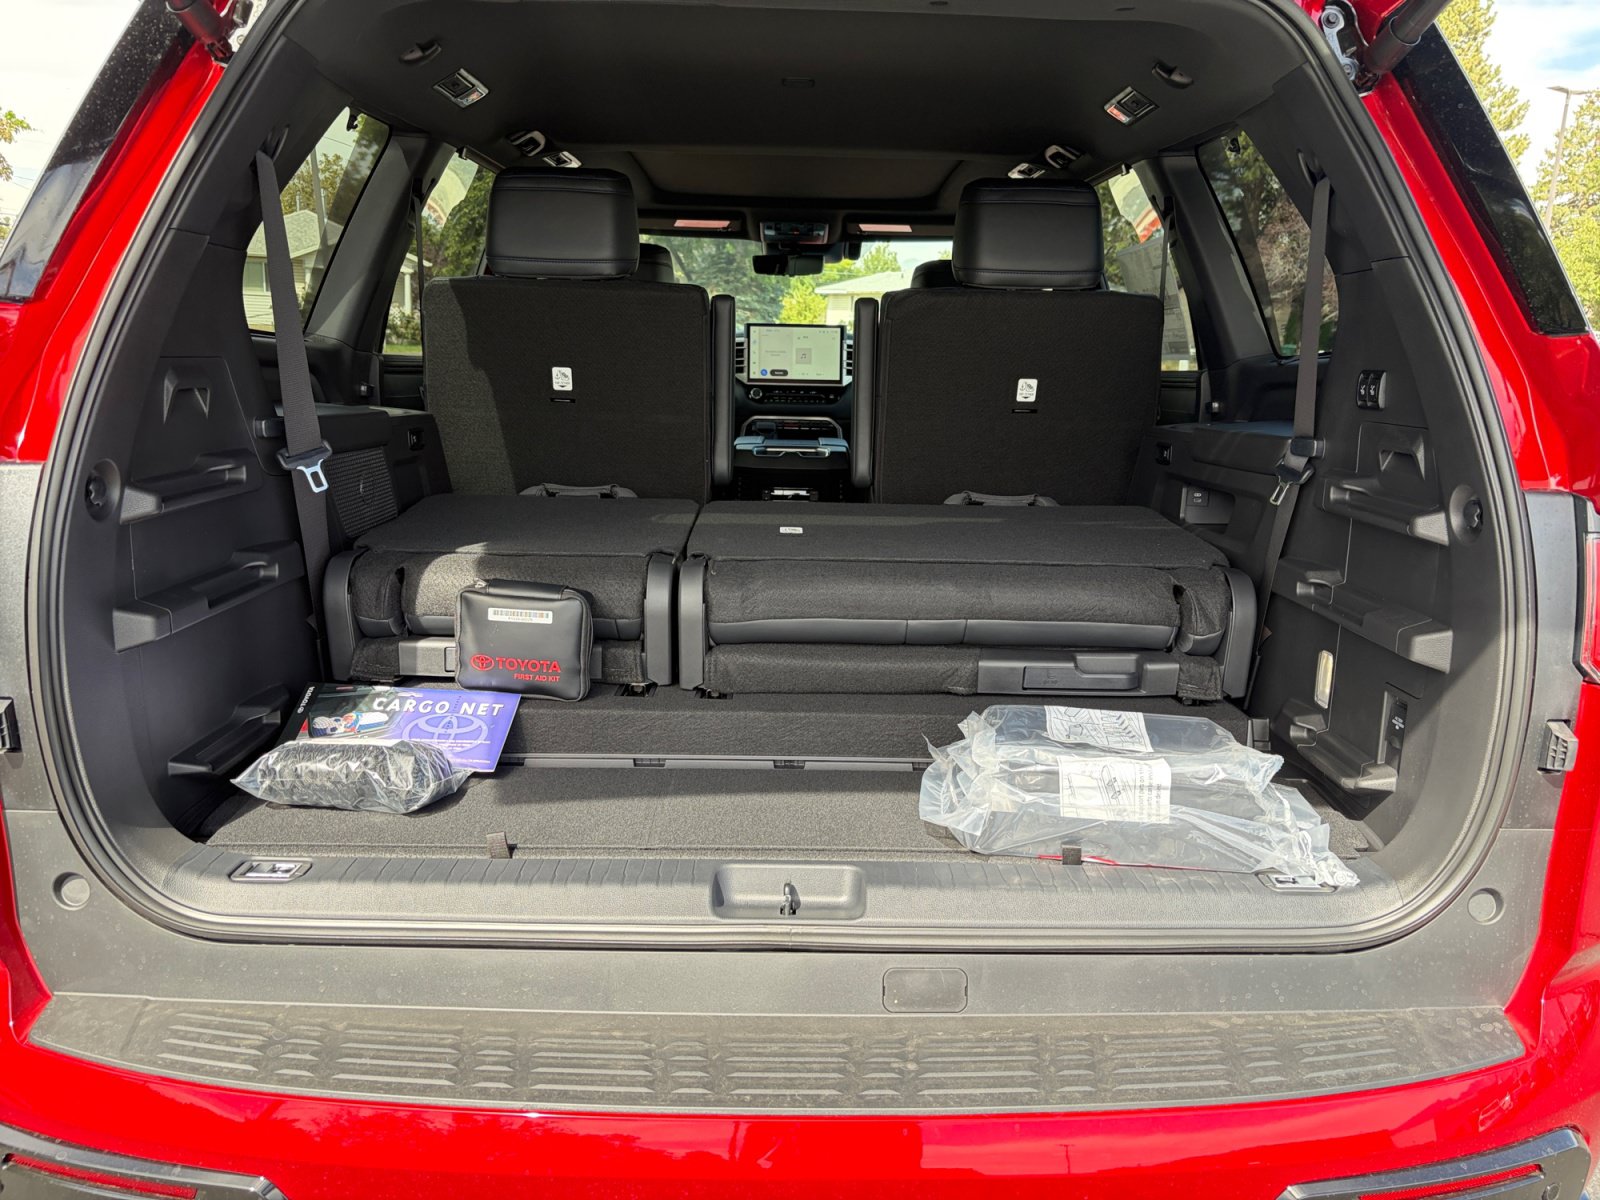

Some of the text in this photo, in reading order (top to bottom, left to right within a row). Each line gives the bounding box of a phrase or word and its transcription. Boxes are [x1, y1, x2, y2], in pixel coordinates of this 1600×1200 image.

[496, 657, 561, 673] TOYOTA
[513, 673, 533, 681] FIRST
[549, 674, 560, 682] KIT
[301, 686, 316, 709] TOYOTA
[373, 697, 504, 717] CARGO NET
